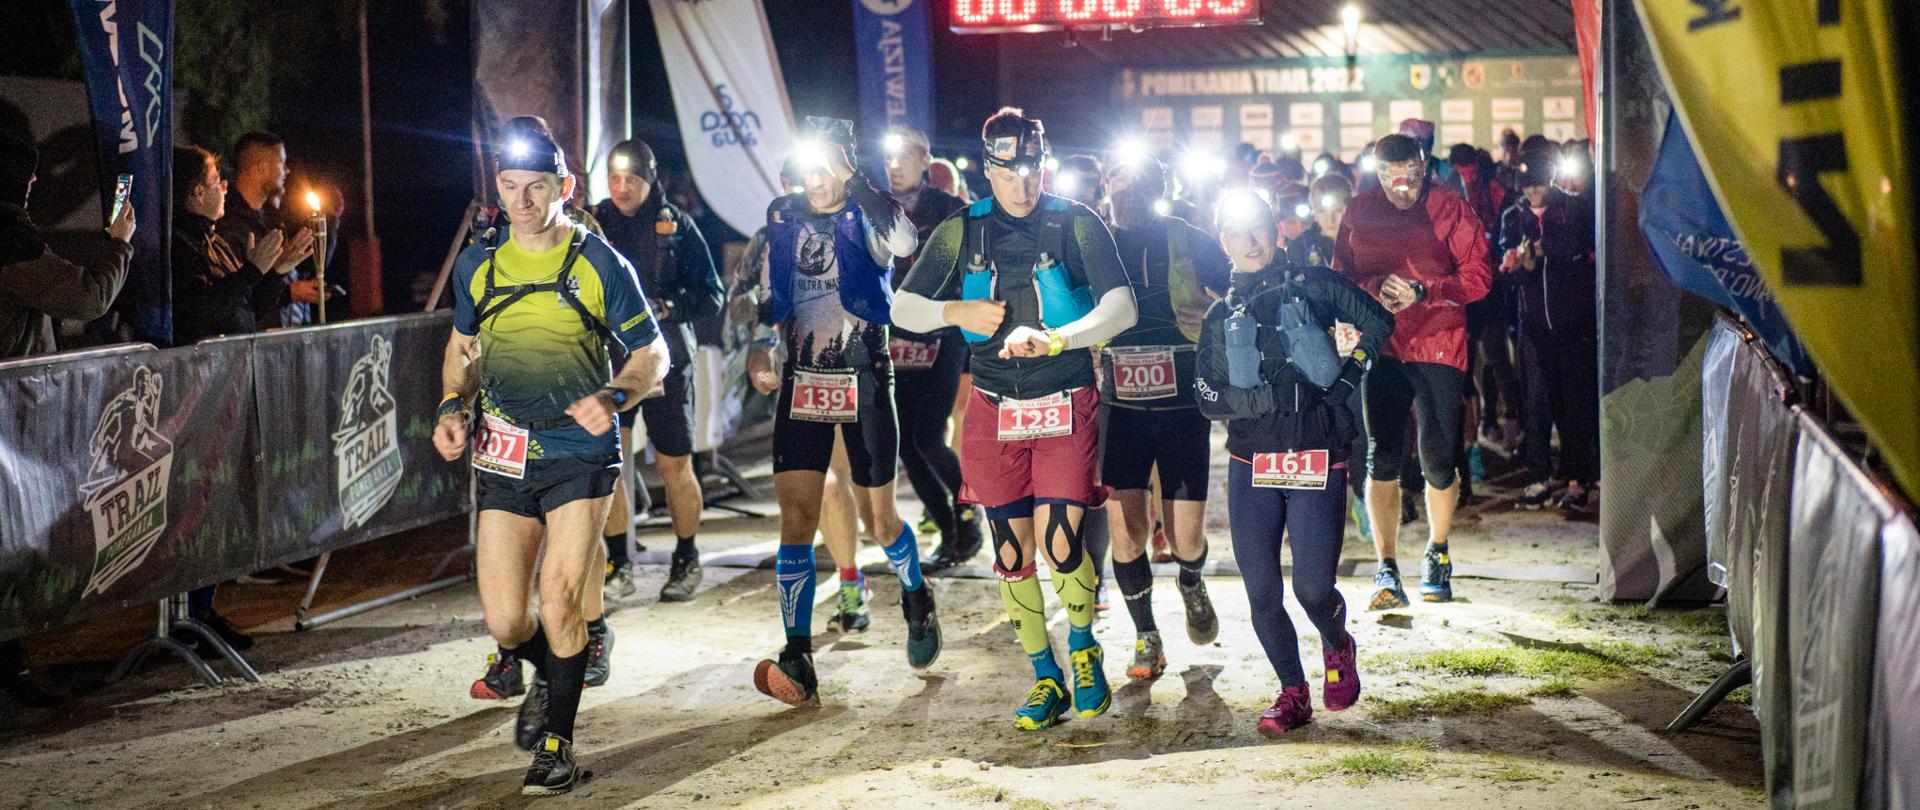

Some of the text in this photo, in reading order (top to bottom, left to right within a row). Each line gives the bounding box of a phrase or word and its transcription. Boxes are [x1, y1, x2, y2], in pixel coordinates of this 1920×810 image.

[896, 347, 929, 362] 134
[1121, 364, 1166, 387] 200
[803, 387, 847, 411] 139
[1011, 407, 1060, 430] 128
[345, 420, 390, 480] TRAIL
[478, 429, 517, 459] 207
[1264, 453, 1315, 474] 161
[100, 466, 161, 538] TRAIL
